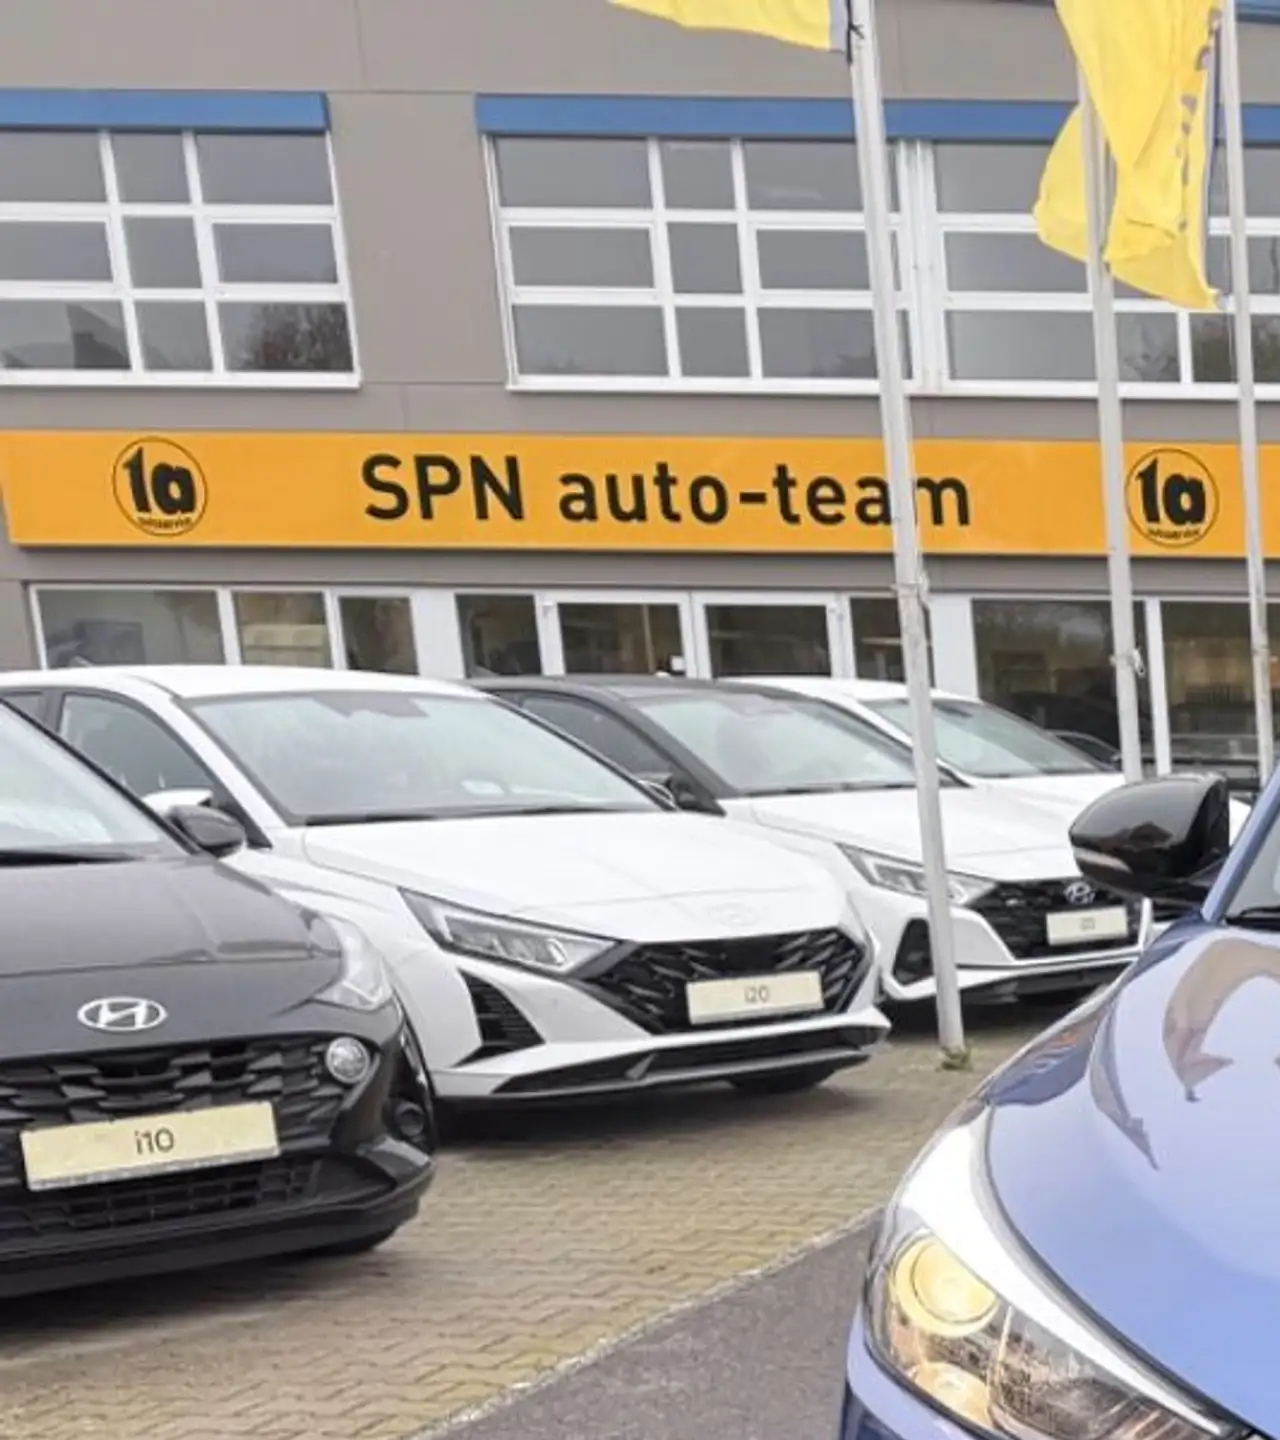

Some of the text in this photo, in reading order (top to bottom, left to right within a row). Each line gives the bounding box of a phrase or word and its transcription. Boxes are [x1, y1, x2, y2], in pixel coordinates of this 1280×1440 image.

[362, 454, 970, 527] SPN auto-team
[134, 1128, 175, 1155] i10
